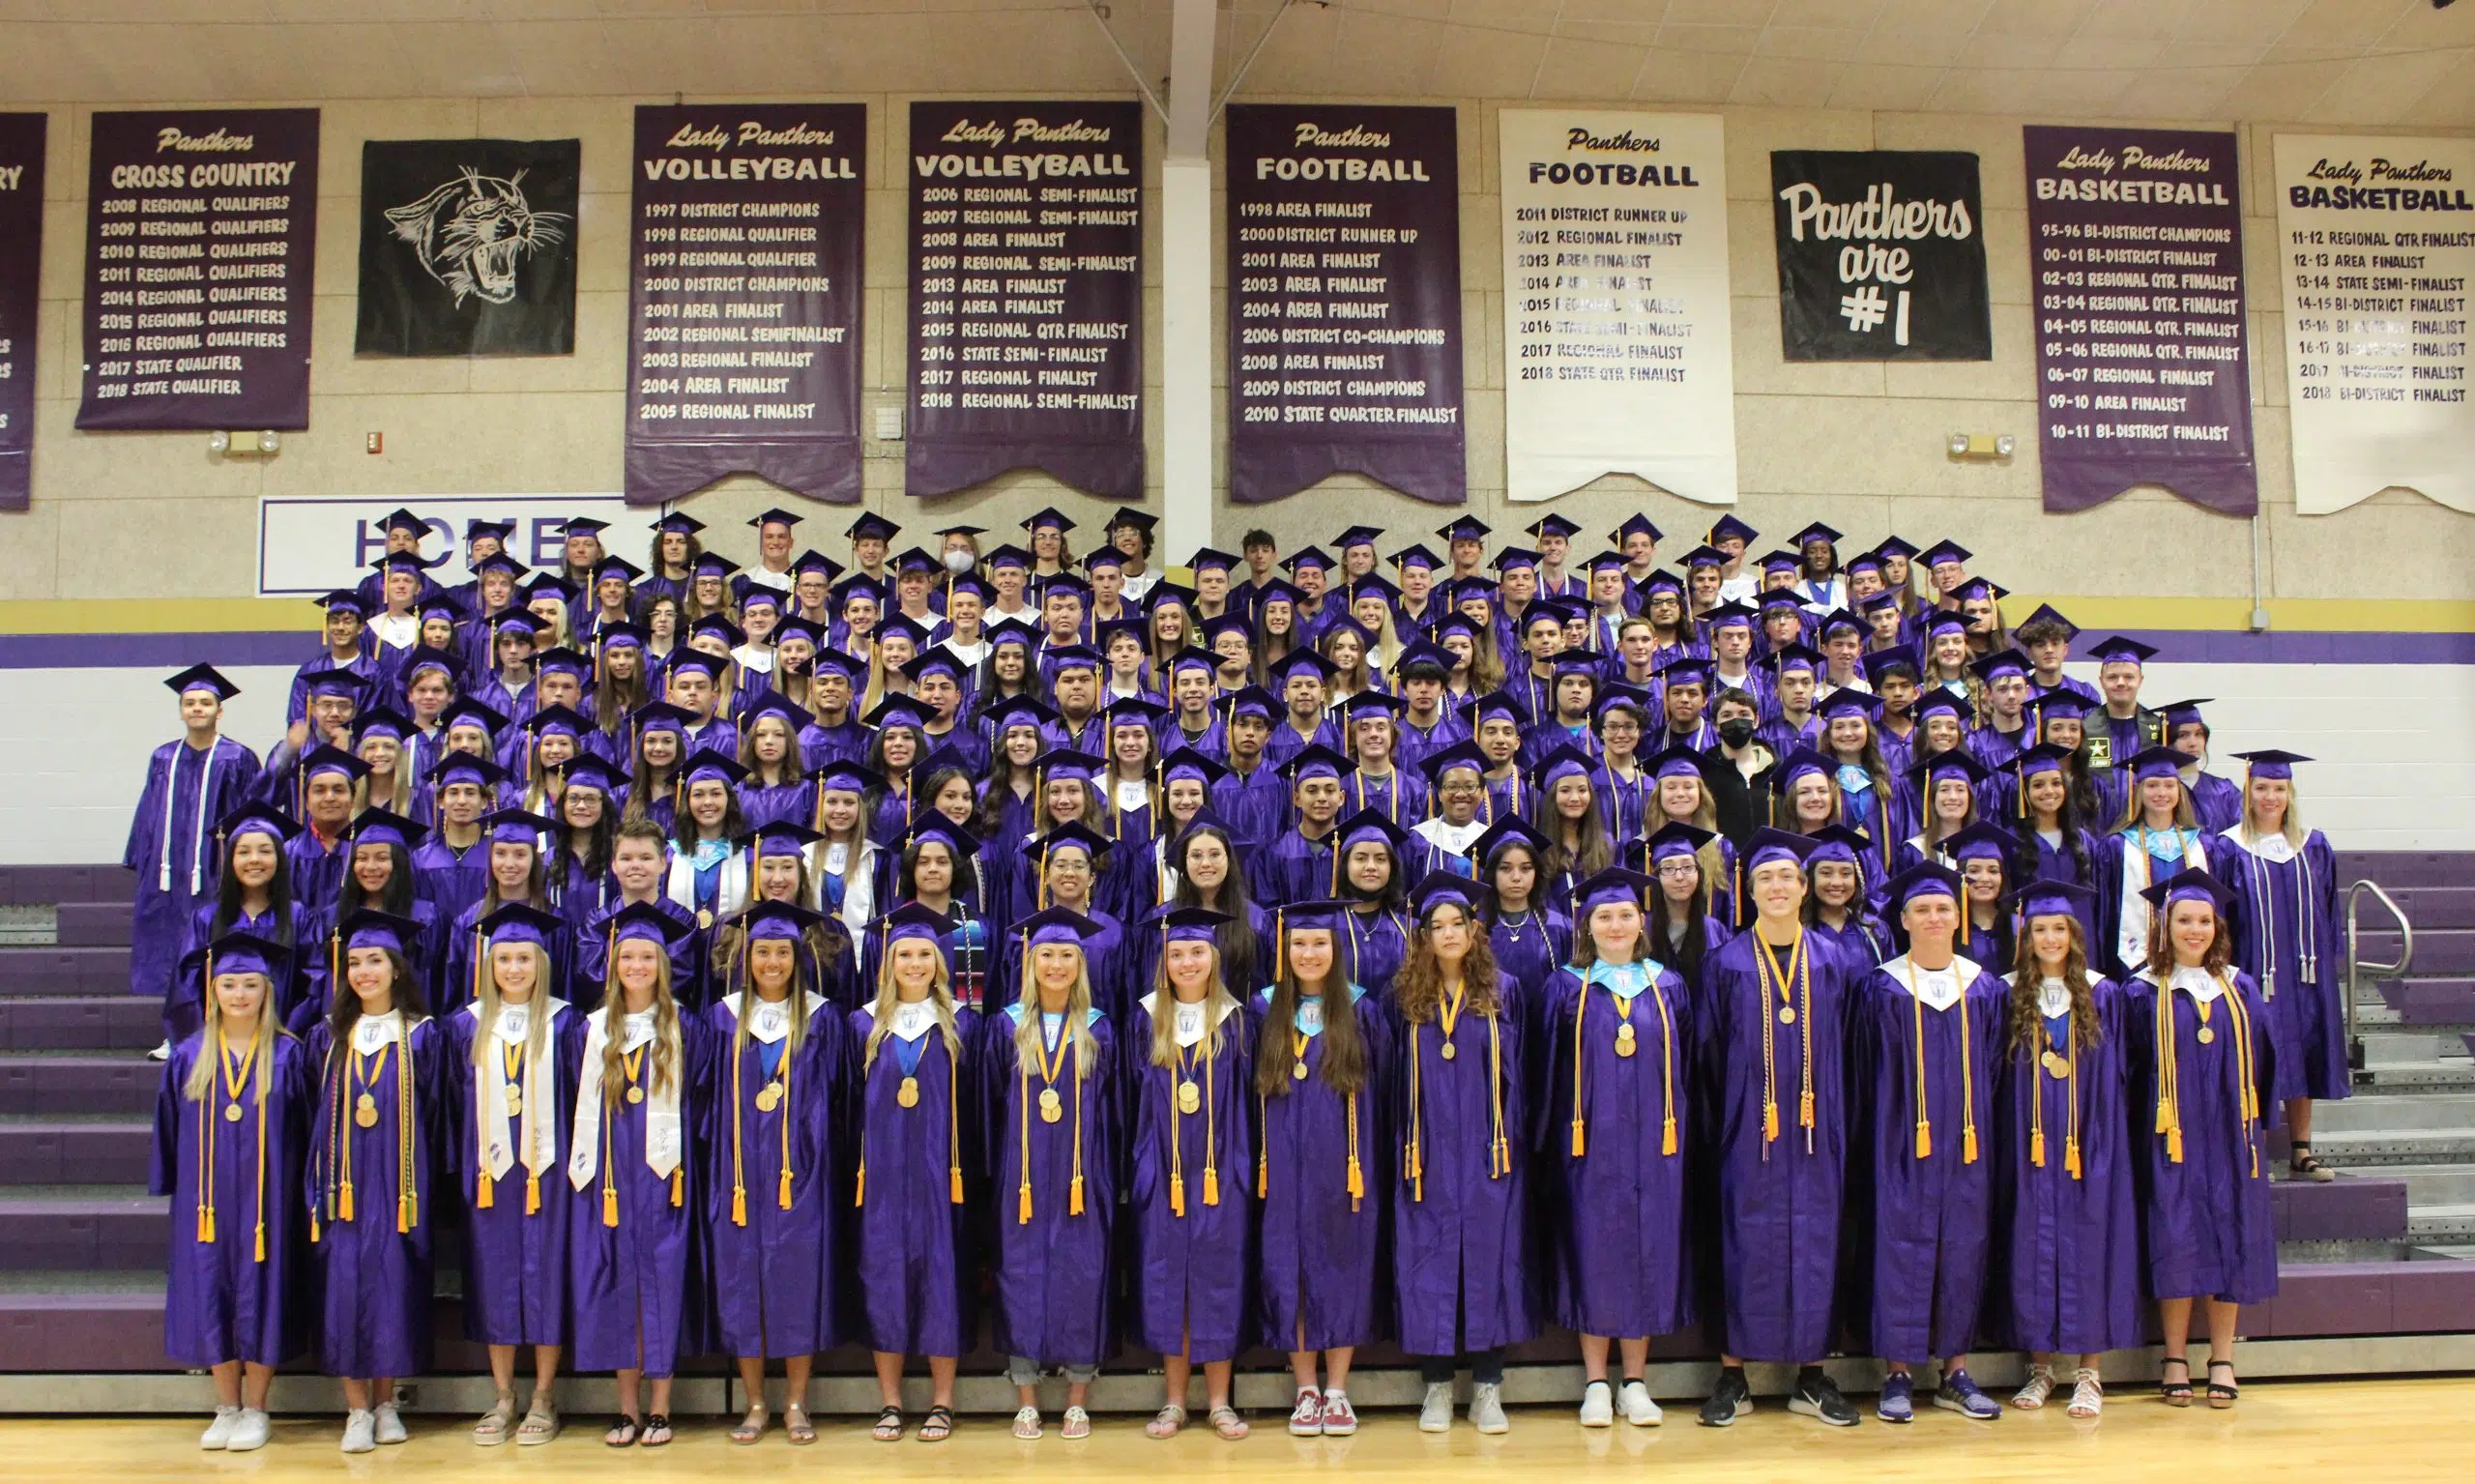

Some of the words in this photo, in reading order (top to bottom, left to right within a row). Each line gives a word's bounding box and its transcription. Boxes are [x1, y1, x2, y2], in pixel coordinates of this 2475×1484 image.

[157, 128, 253, 153] Panthers
[666, 123, 730, 153] Lady
[738, 122, 833, 146] Panthers
[941, 119, 1005, 148] Lady
[1012, 118, 1110, 143] Panthers
[1295, 123, 1390, 148] Panthers
[1567, 128, 1660, 152] Panthers
[644, 157, 857, 181] VOLLEYBALL
[916, 154, 1129, 182] VOLLEYBALL
[2057, 146, 2115, 175] Lady
[2122, 146, 2210, 172] Panthers
[111, 164, 185, 189] CROSS
[190, 161, 296, 188] COUNTRY
[1257, 158, 1430, 182] FOOTBALL
[1529, 162, 1699, 187] FOOTBALL
[2307, 159, 2363, 187] Lady
[2370, 158, 2452, 182] Panthers
[923, 188, 958, 202] 2006
[964, 188, 1033, 202] REGIONAL
[1039, 188, 1137, 203] SEMI-FINALIST
[2036, 178, 2229, 205] BASKETBALL
[2289, 186, 2474, 212] BASKETBALL
[102, 199, 137, 214] 2008
[141, 198, 208, 214] REGIONAL
[212, 195, 290, 212] QUALIFIERS
[645, 204, 677, 218] 1997
[681, 203, 740, 218] DISTRICT
[742, 202, 820, 218] CHAMPIONS
[1240, 203, 1272, 217] 1998
[1276, 202, 1311, 218] AREA
[1315, 203, 1372, 218] FINALIST
[1779, 183, 1972, 242] Panthers
[1516, 208, 1546, 221] 2011
[1551, 207, 1609, 221] DISTRICT
[1615, 208, 1667, 222] RUNNER
[644, 227, 676, 242] 1998
[680, 227, 745, 242] REGIONAL
[747, 227, 817, 243] QUALIFIER
[922, 232, 957, 247] 2008
[963, 233, 999, 247] AREA
[1005, 232, 1065, 247] FINALIST
[1239, 227, 1275, 241] 2000
[1277, 227, 1336, 243] DISTRICT
[1341, 227, 1396, 243] RUNNER
[1400, 229, 1417, 244] UP
[2042, 223, 2081, 238] 95-96
[2084, 224, 2158, 240] BI-DISTRICT
[2159, 227, 2231, 243] CHAMPIONS
[2292, 231, 2324, 245] 11-12
[2329, 231, 2390, 247] REGIONAL
[2395, 232, 2420, 247] QTR
[100, 245, 134, 259] 2010
[139, 244, 205, 259] REGIONAL
[210, 241, 288, 259] QUALIFIERS
[2043, 247, 2083, 262] 00-01
[2087, 247, 2161, 264] BI-DISTRICT
[2163, 251, 2217, 267] FINALIST
[922, 255, 956, 271] 2009
[963, 255, 1033, 271] REGIONAL
[1038, 255, 1137, 272] SEMI-FINALIST
[1242, 252, 1275, 267] 2001
[1280, 252, 1315, 269] AREA
[1323, 253, 1381, 269] FINALIST
[1839, 243, 1913, 284] are
[2294, 253, 2329, 267] 12-13
[2335, 254, 2366, 268] AREA
[2373, 255, 2425, 269] FINALIST
[100, 267, 131, 282] 2011
[136, 265, 204, 282] REGIONAL
[209, 263, 286, 280] QUALIFIERS
[2043, 271, 2083, 286] 02-03
[2087, 272, 2149, 288] REGIONAL
[2181, 274, 2237, 291] FINALIST
[644, 277, 680, 291] 2000
[684, 276, 745, 292] DISTRICT
[748, 276, 830, 292] CHAMPIONS
[922, 277, 955, 293] 2013
[962, 278, 999, 293] AREA
[1006, 278, 1066, 294] FINALIST
[1241, 276, 1278, 292] 2003
[1285, 276, 1321, 293] AREA
[1327, 276, 1387, 293] FINALIST
[2296, 275, 2330, 289] 13-14
[2336, 276, 2369, 290] STATE
[101, 291, 134, 306] 2014
[137, 289, 205, 306] REGIONAL
[209, 286, 287, 303] QUALIFIERS
[2297, 296, 2332, 310] 14-15
[2335, 297, 2403, 312] BI-DISTRICT
[2410, 298, 2465, 312] FINALIST
[644, 304, 678, 318] 2001
[683, 304, 718, 319] AREA
[725, 303, 784, 318] FINALIST
[1840, 286, 1910, 346] #1
[643, 327, 679, 342] 2002
[682, 327, 748, 343] REGIONAL
[751, 326, 845, 343] SEMIFINALIST
[921, 323, 954, 336] 2015
[962, 322, 1032, 338] REGIONAL
[1036, 323, 1065, 339] QTR
[1067, 323, 1128, 339] FINALIST
[1242, 328, 1279, 343] 2006
[1282, 328, 1341, 344] DISTRICT
[1343, 329, 1445, 345] CO-CHAMPIONS
[642, 352, 679, 367] 2003
[681, 352, 748, 368] REGIONAL
[751, 351, 814, 367] FINALIST
[920, 345, 954, 361] 2016
[962, 346, 1001, 361] STATE
[2046, 342, 2088, 357] 05-06
[2091, 342, 2153, 358] REGIONAL
[2185, 346, 2240, 362] FINALIST
[99, 361, 131, 376] 2017
[135, 359, 173, 375] STATE
[175, 356, 243, 372] QUALIFIER
[641, 378, 680, 394] 2004
[684, 376, 722, 393] AREA
[728, 377, 790, 393] FINALIST
[920, 369, 953, 385] 2017
[962, 370, 1032, 386] REGIONAL
[1038, 370, 1097, 387] FINALIST
[2048, 367, 2088, 382] 06-07
[2093, 367, 2155, 384] REGIONAL
[2160, 369, 2215, 386] FINALIST
[98, 383, 129, 398] 2018
[131, 380, 169, 395] STATE
[172, 379, 242, 394] QUALIFIER
[1243, 380, 1280, 396] 2009
[1284, 380, 1342, 395] DISTRICT
[1347, 380, 1426, 396] CHAMPIONS
[920, 393, 952, 408] 2018
[962, 393, 1033, 409] REGIONAL
[1036, 393, 1138, 410] SEMI-FINALIST
[2049, 394, 2089, 409] 09-10
[2095, 395, 2128, 410] AREA
[2132, 396, 2187, 412] FINALIST
[1244, 406, 1279, 422] 2010
[1284, 405, 1325, 422] STATE
[1329, 407, 1396, 422] QUARTER
[1396, 407, 1457, 423] FINALIST
[2051, 424, 2089, 439] 10-11
[2096, 423, 2169, 439] BI-DISTRICT
[2173, 425, 2229, 441] FINALIST
